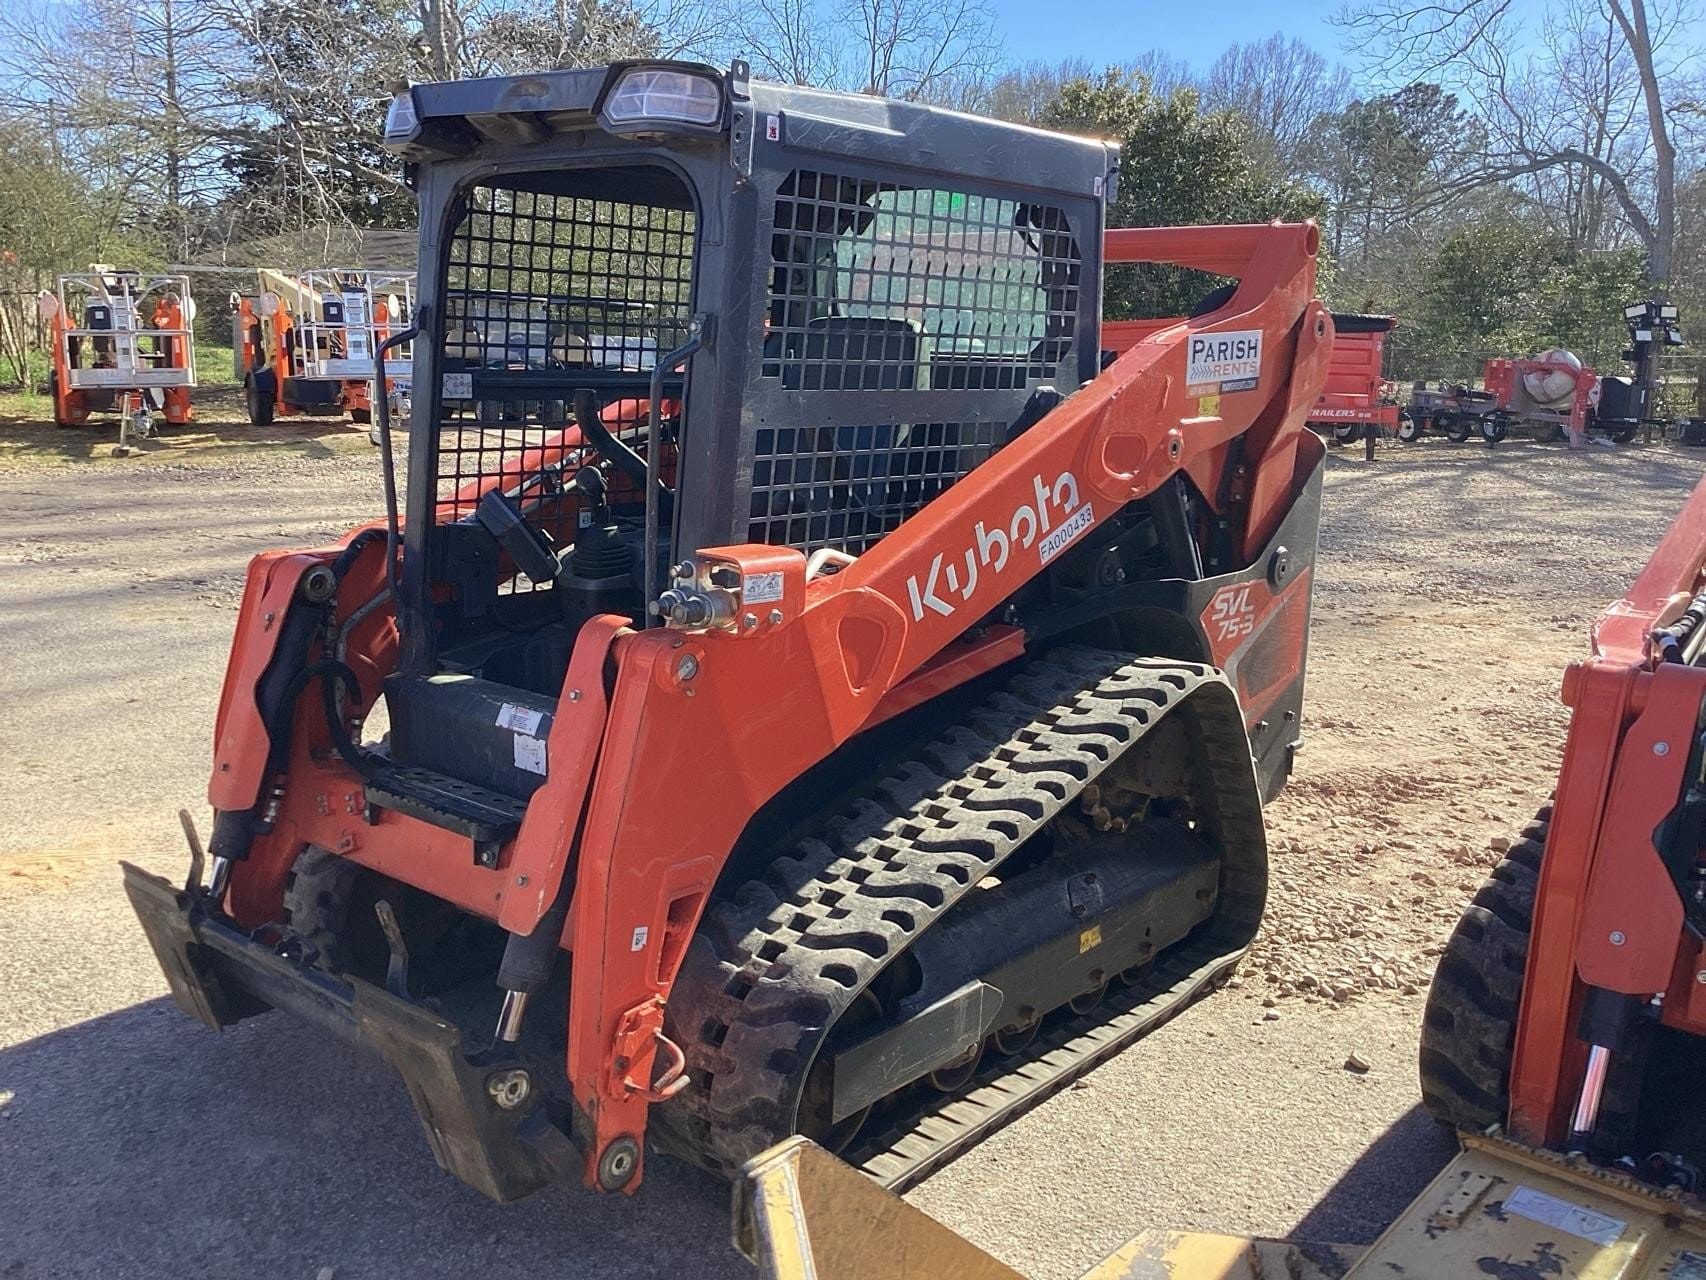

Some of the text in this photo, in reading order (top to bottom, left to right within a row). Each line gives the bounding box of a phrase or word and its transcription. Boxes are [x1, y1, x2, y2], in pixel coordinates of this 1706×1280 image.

[1192, 338, 1258, 364] PARISH
[1213, 361, 1257, 377] RENTS
[906, 471, 1080, 622] Kubota
[1041, 508, 1092, 560] FA000433
[1212, 588, 1254, 621] SVL
[1217, 614, 1254, 642] 75-3
